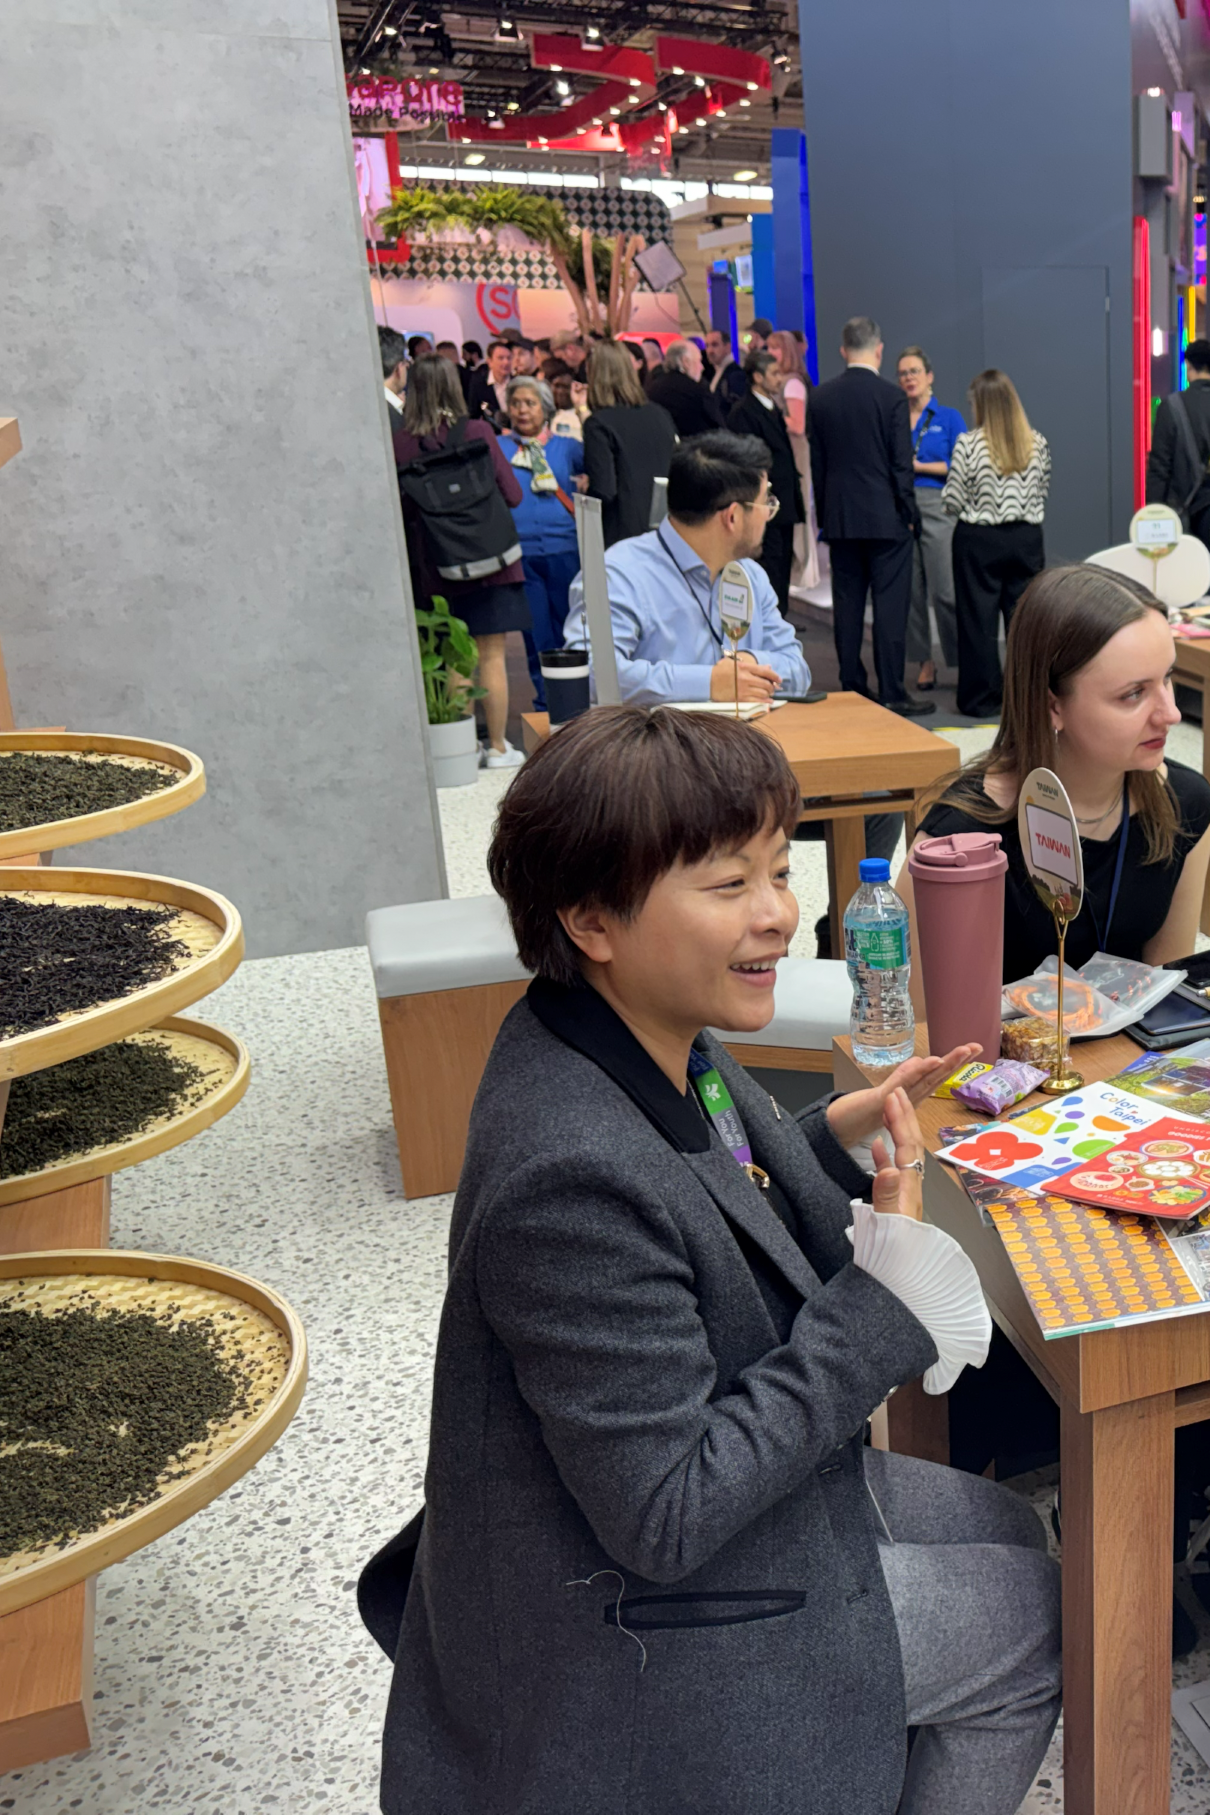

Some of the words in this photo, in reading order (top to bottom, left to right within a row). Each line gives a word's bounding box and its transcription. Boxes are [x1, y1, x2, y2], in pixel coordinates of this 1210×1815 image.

[1036, 782, 1059, 797] TAIWAN
[1035, 832, 1071, 859] TAIWAN
[1100, 1092, 1139, 1110] Color
[724, 1110, 738, 1134] Youth
[1109, 1106, 1152, 1126] Taipei
[719, 1117, 729, 1134] You
[725, 1133, 735, 1147] For
[734, 1133, 745, 1147] For
[1167, 1131, 1206, 1141] GOODIES
